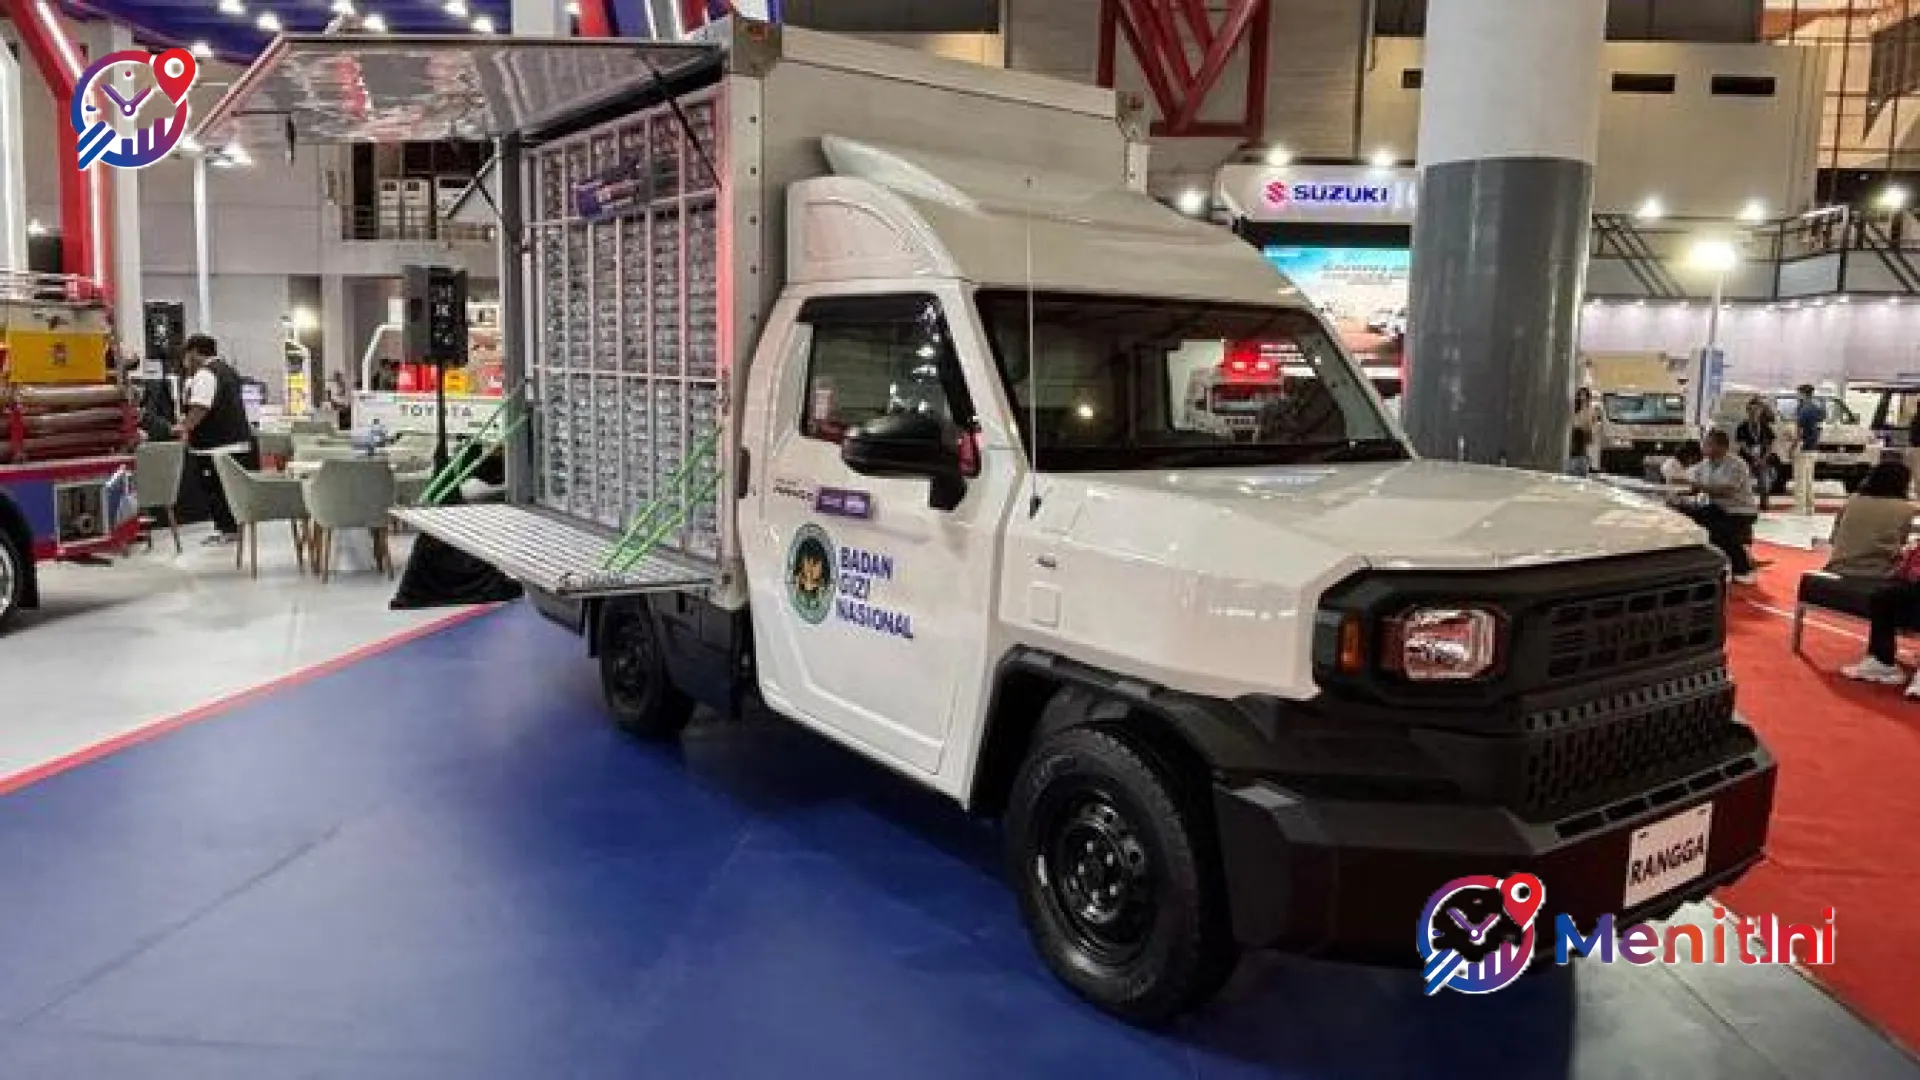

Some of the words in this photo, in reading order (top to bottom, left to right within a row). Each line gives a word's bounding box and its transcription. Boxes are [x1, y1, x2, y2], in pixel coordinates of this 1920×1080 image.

[1293, 184, 1388, 203] SUZUKI
[401, 404, 472, 417] TOYTA
[840, 546, 894, 580] BADAN
[838, 572, 871, 600] GIZI
[836, 598, 914, 639] NASIONAL
[1628, 832, 1705, 887] RANGGA
